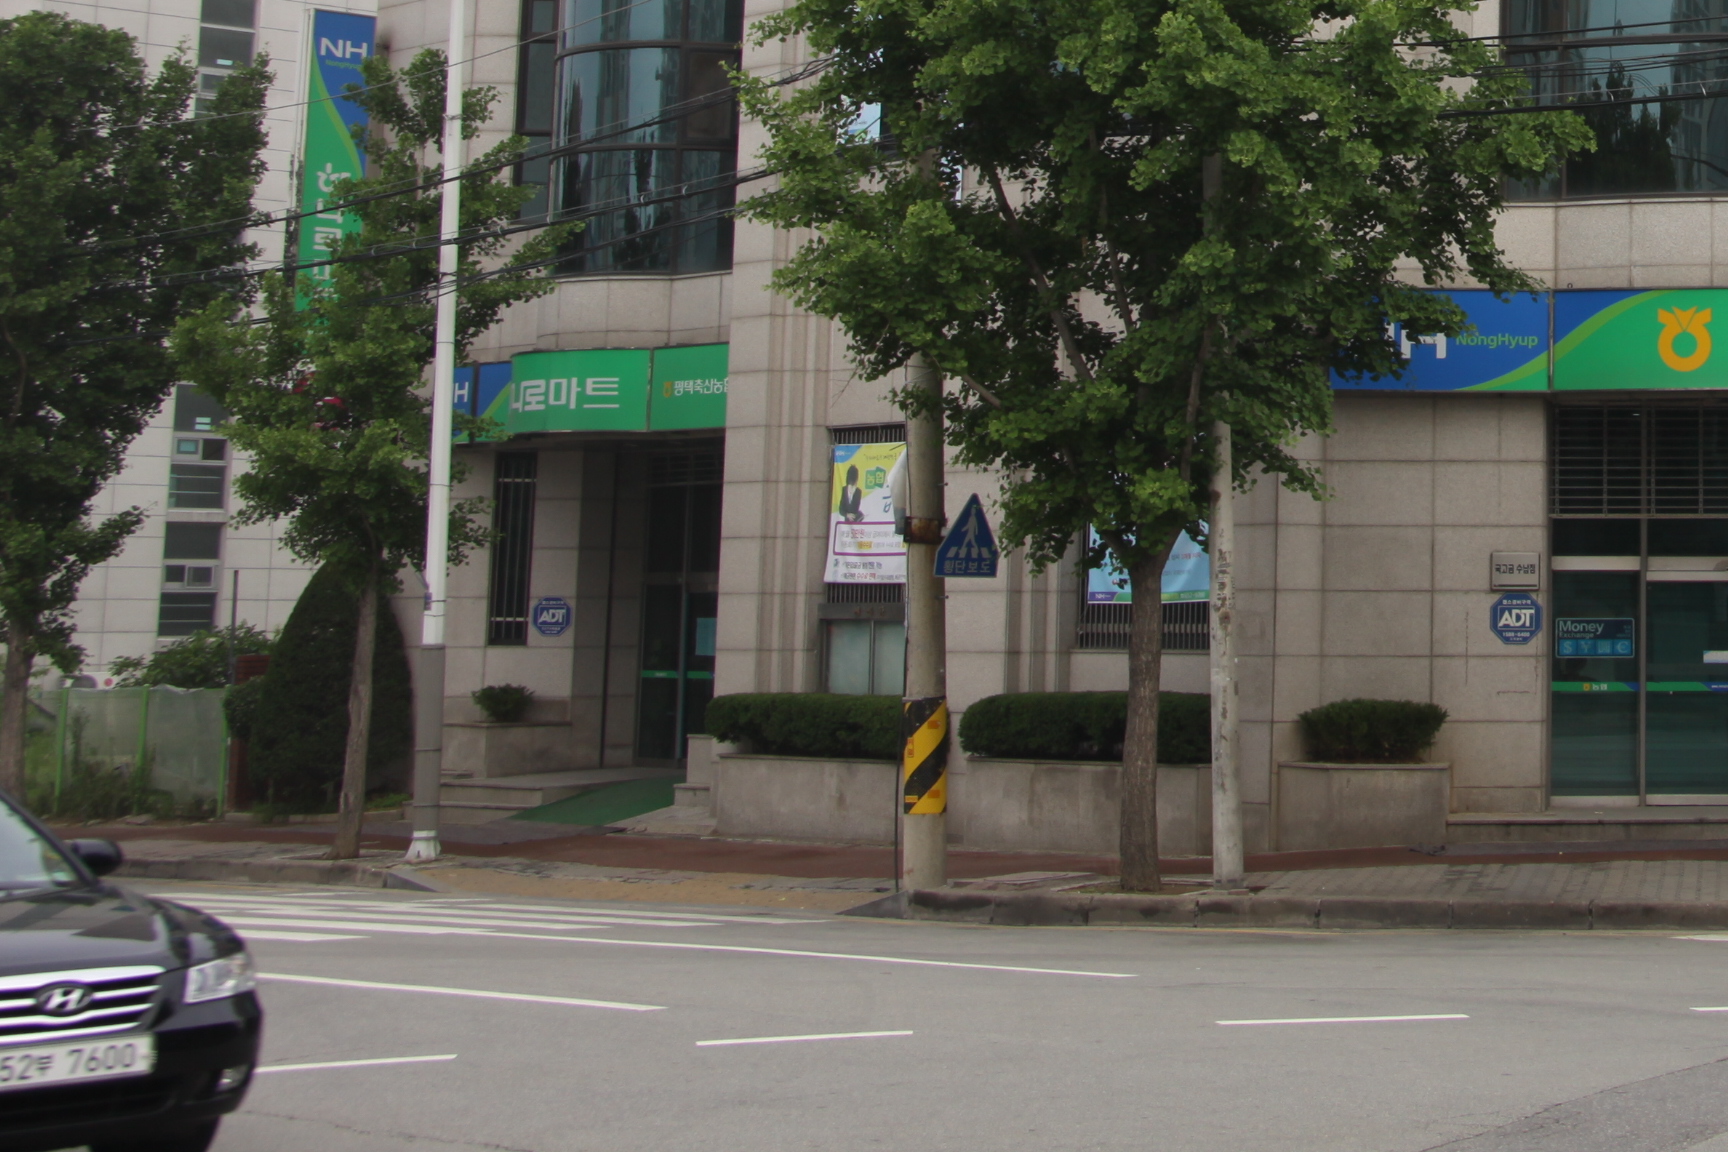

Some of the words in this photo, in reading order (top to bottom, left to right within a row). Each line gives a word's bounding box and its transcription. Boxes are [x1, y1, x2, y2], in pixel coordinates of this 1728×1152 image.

[319, 36, 369, 59] NH
[1455, 332, 1539, 350] NongHyup
[942, 559, 991, 574] 횡단보도
[1495, 563, 1515, 574] 국고금
[538, 608, 566, 623] ADT
[1498, 608, 1535, 627] ADT
[1559, 620, 1604, 635] Money
[1559, 632, 1594, 640] Exchange
[66, 1042, 137, 1075] 7600
